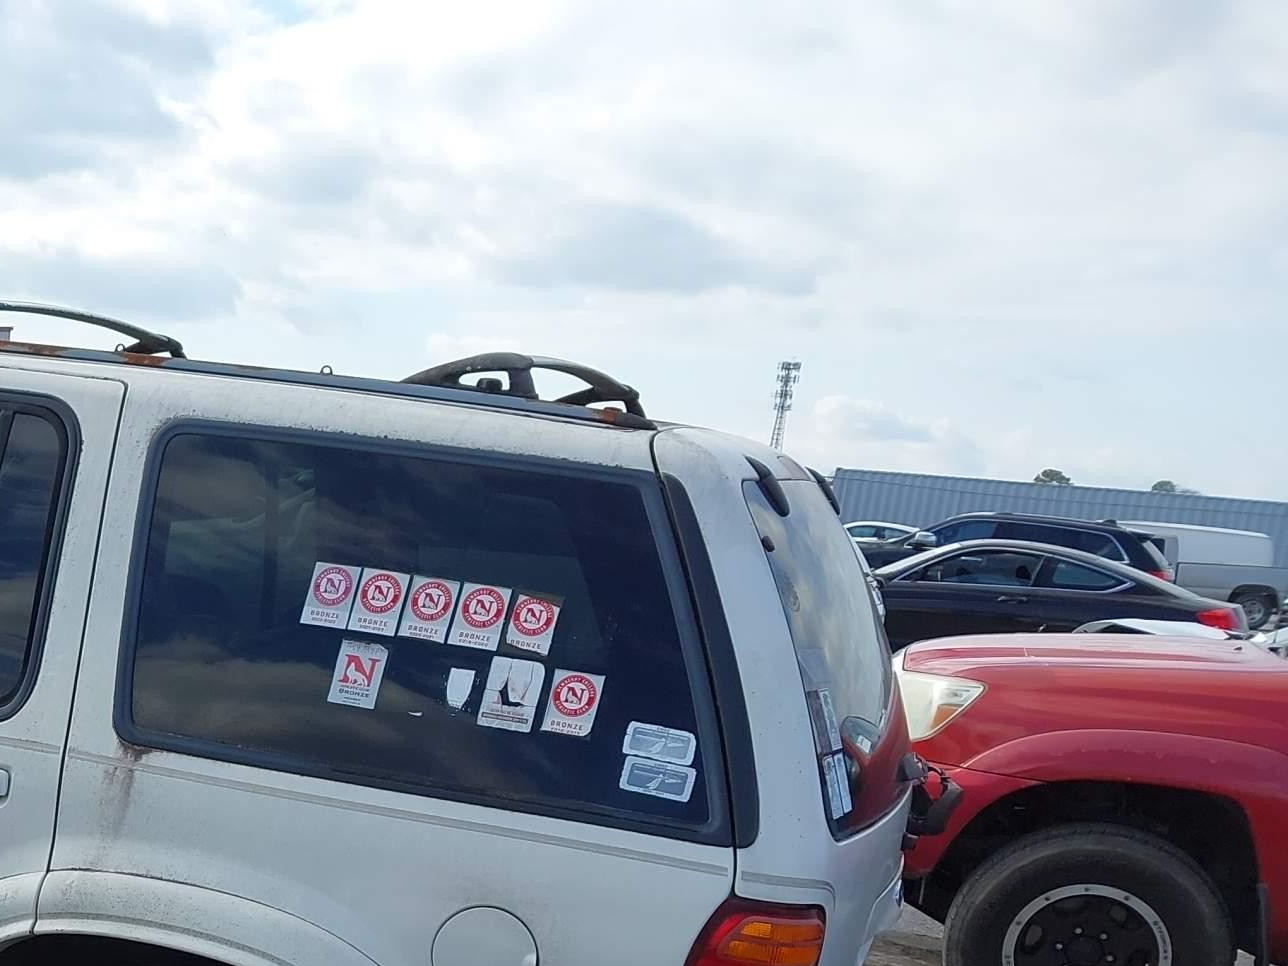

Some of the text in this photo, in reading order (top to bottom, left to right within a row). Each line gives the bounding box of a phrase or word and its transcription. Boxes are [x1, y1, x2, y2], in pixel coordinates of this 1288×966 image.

[310, 609, 339, 619] BRONZE
[357, 617, 389, 627] BRONZE
[408, 624, 439, 635] BRONZE
[458, 631, 491, 642] BRONZE
[337, 653, 383, 687] N
[338, 688, 371, 698] BRONZE
[550, 719, 584, 731] BRONZE
